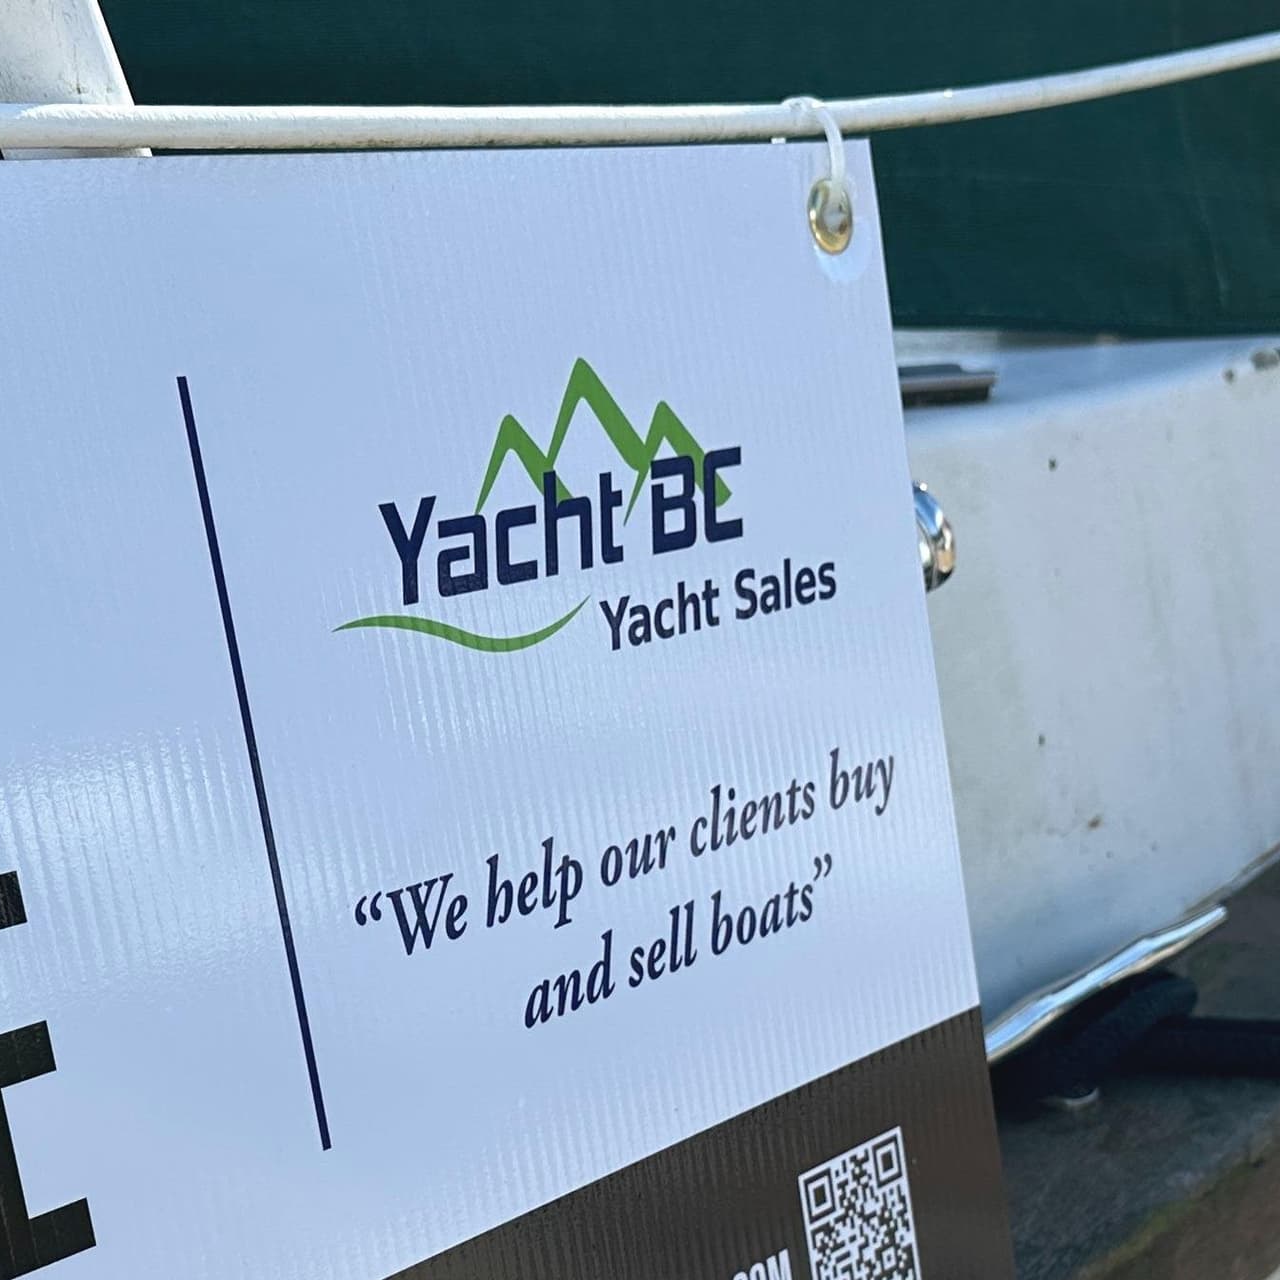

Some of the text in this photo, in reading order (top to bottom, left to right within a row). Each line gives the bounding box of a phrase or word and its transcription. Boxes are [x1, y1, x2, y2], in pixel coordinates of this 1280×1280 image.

[379, 446, 743, 606] Yacht BC
[599, 558, 837, 651] Yacht Sales
[354, 747, 895, 956] “We help our clients buy
[524, 853, 833, 1029] and sell boats”
